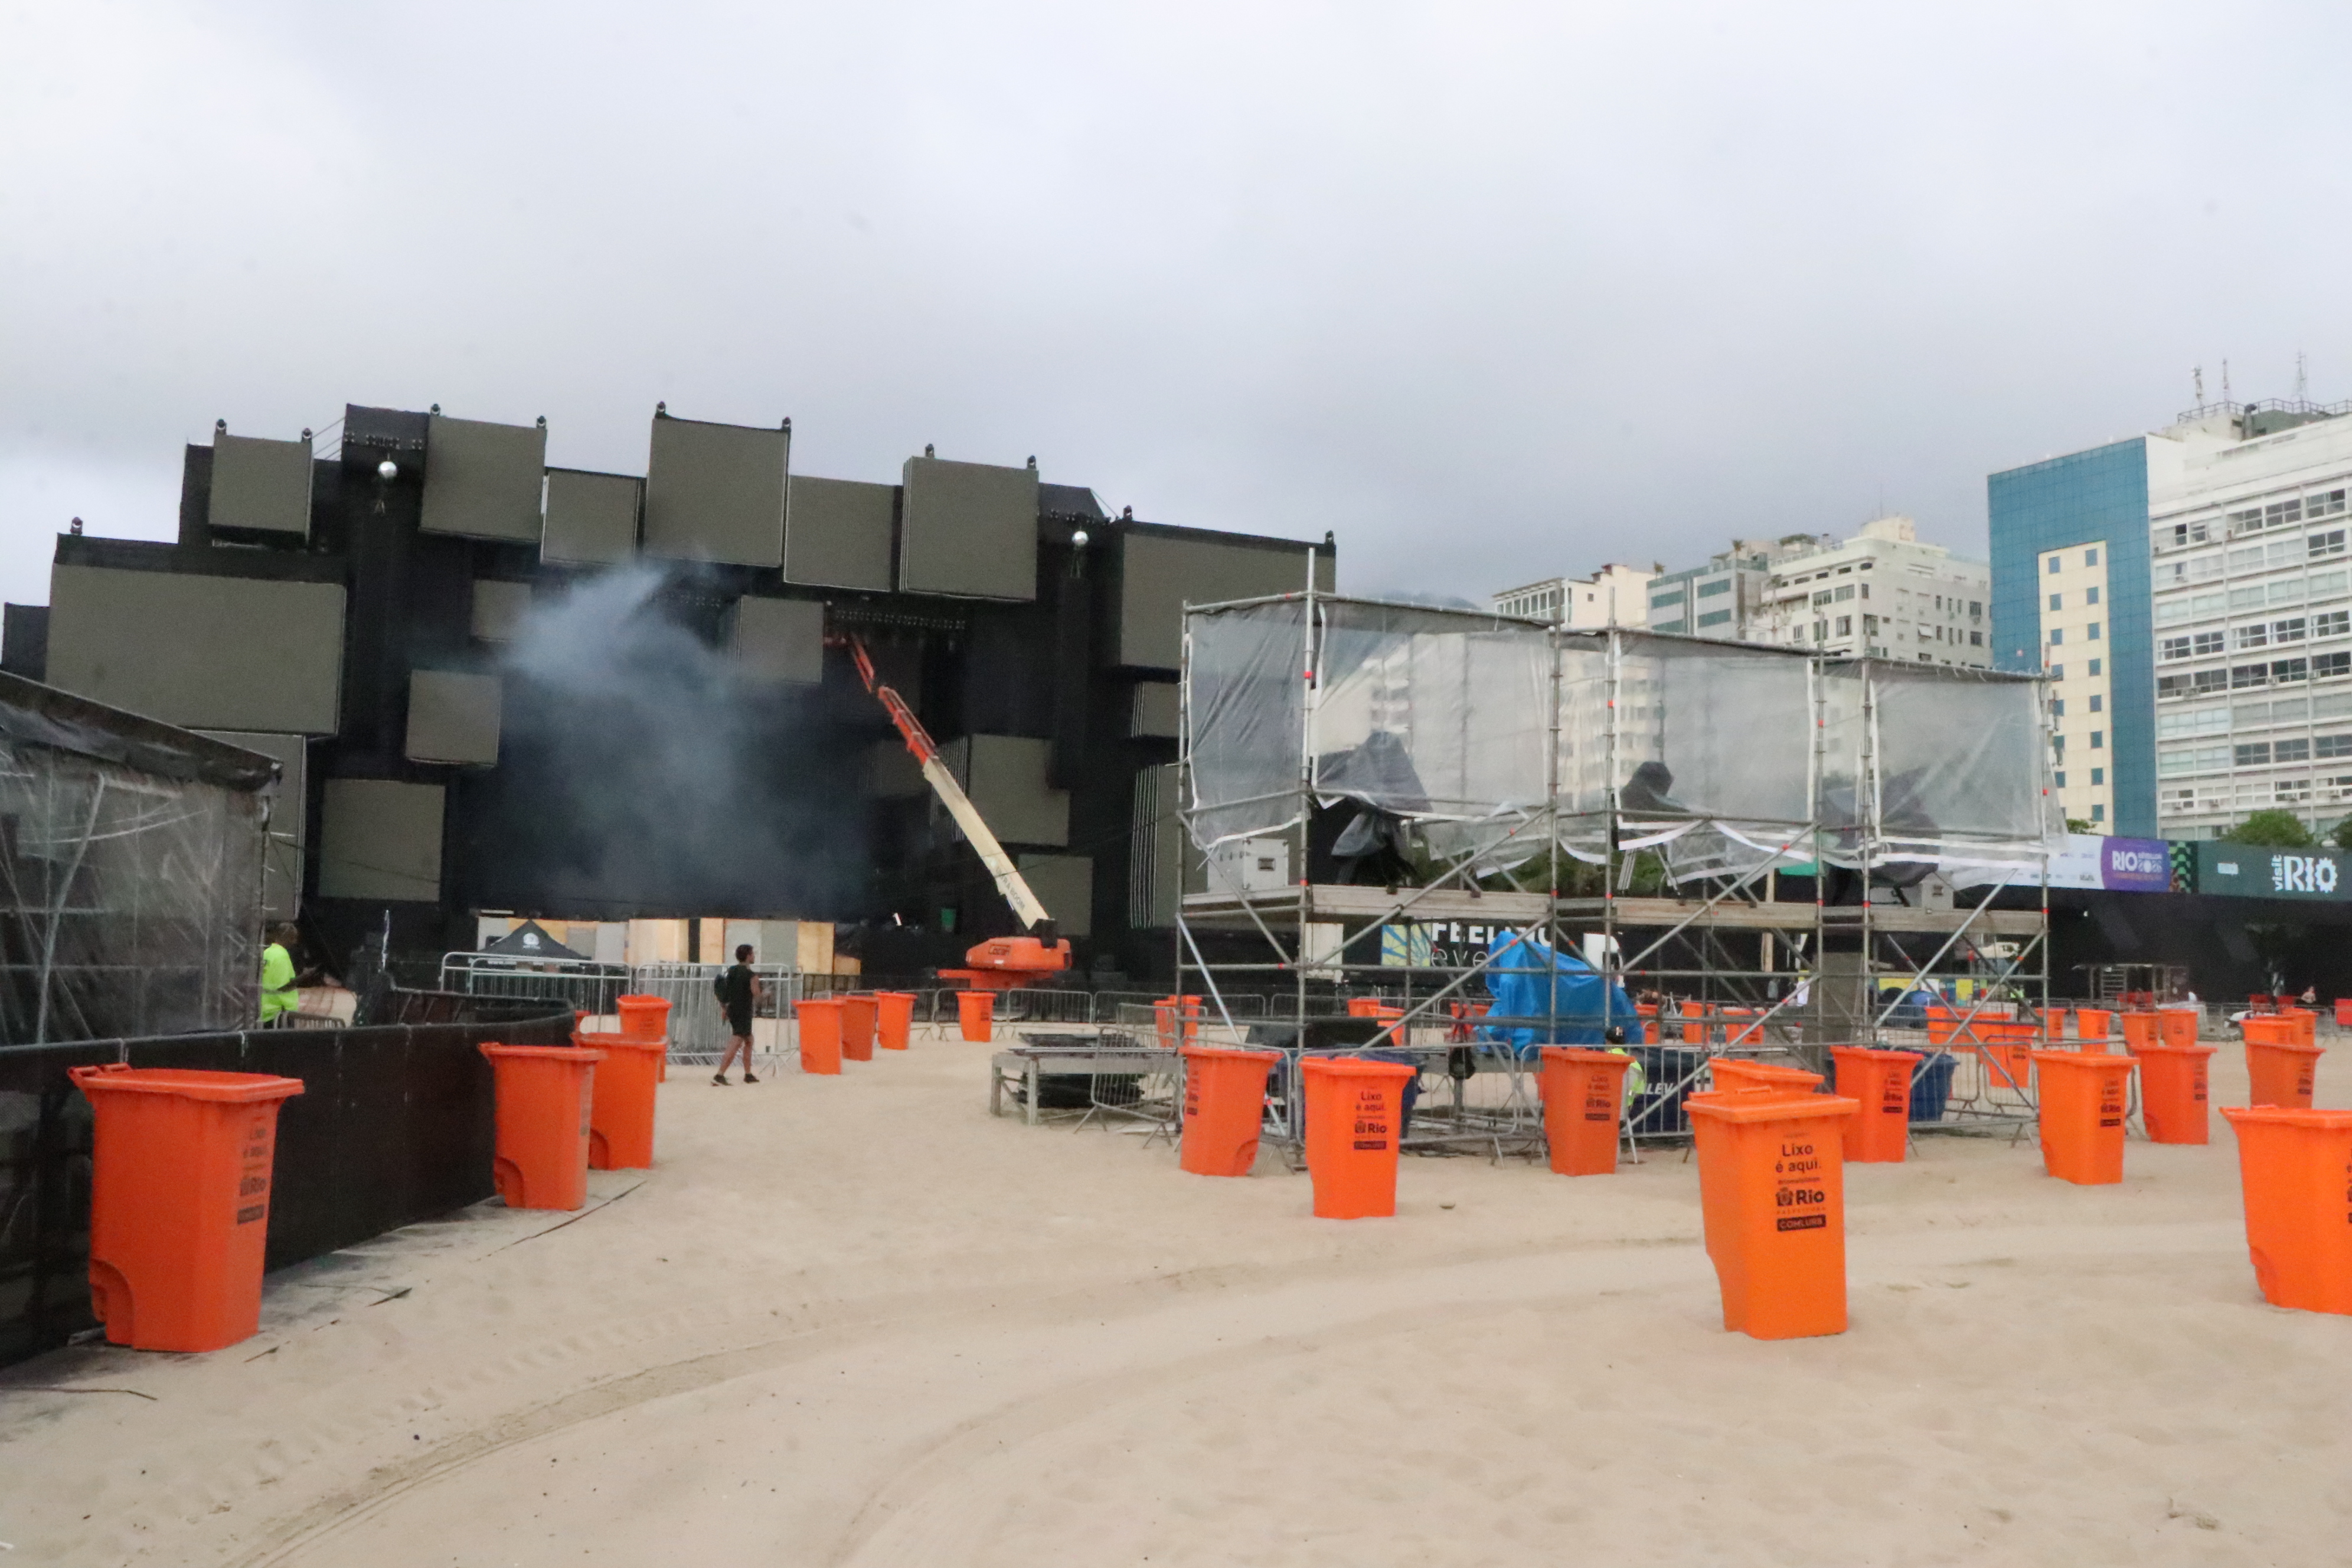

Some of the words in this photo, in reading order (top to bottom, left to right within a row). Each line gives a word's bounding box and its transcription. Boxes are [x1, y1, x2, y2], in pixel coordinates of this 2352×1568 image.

[2112, 850, 2137, 872] RIO
[2271, 854, 2283, 891] visit
[2284, 855, 2338, 893] RIO
[1361, 1091, 1382, 1101] Lixo
[1596, 1099, 1611, 1108] Rio
[1368, 1123, 1387, 1133] Rio
[1782, 1144, 1813, 1157] Lixo
[1788, 1157, 1821, 1174] aqui.
[1796, 1189, 1825, 1205] Rio
